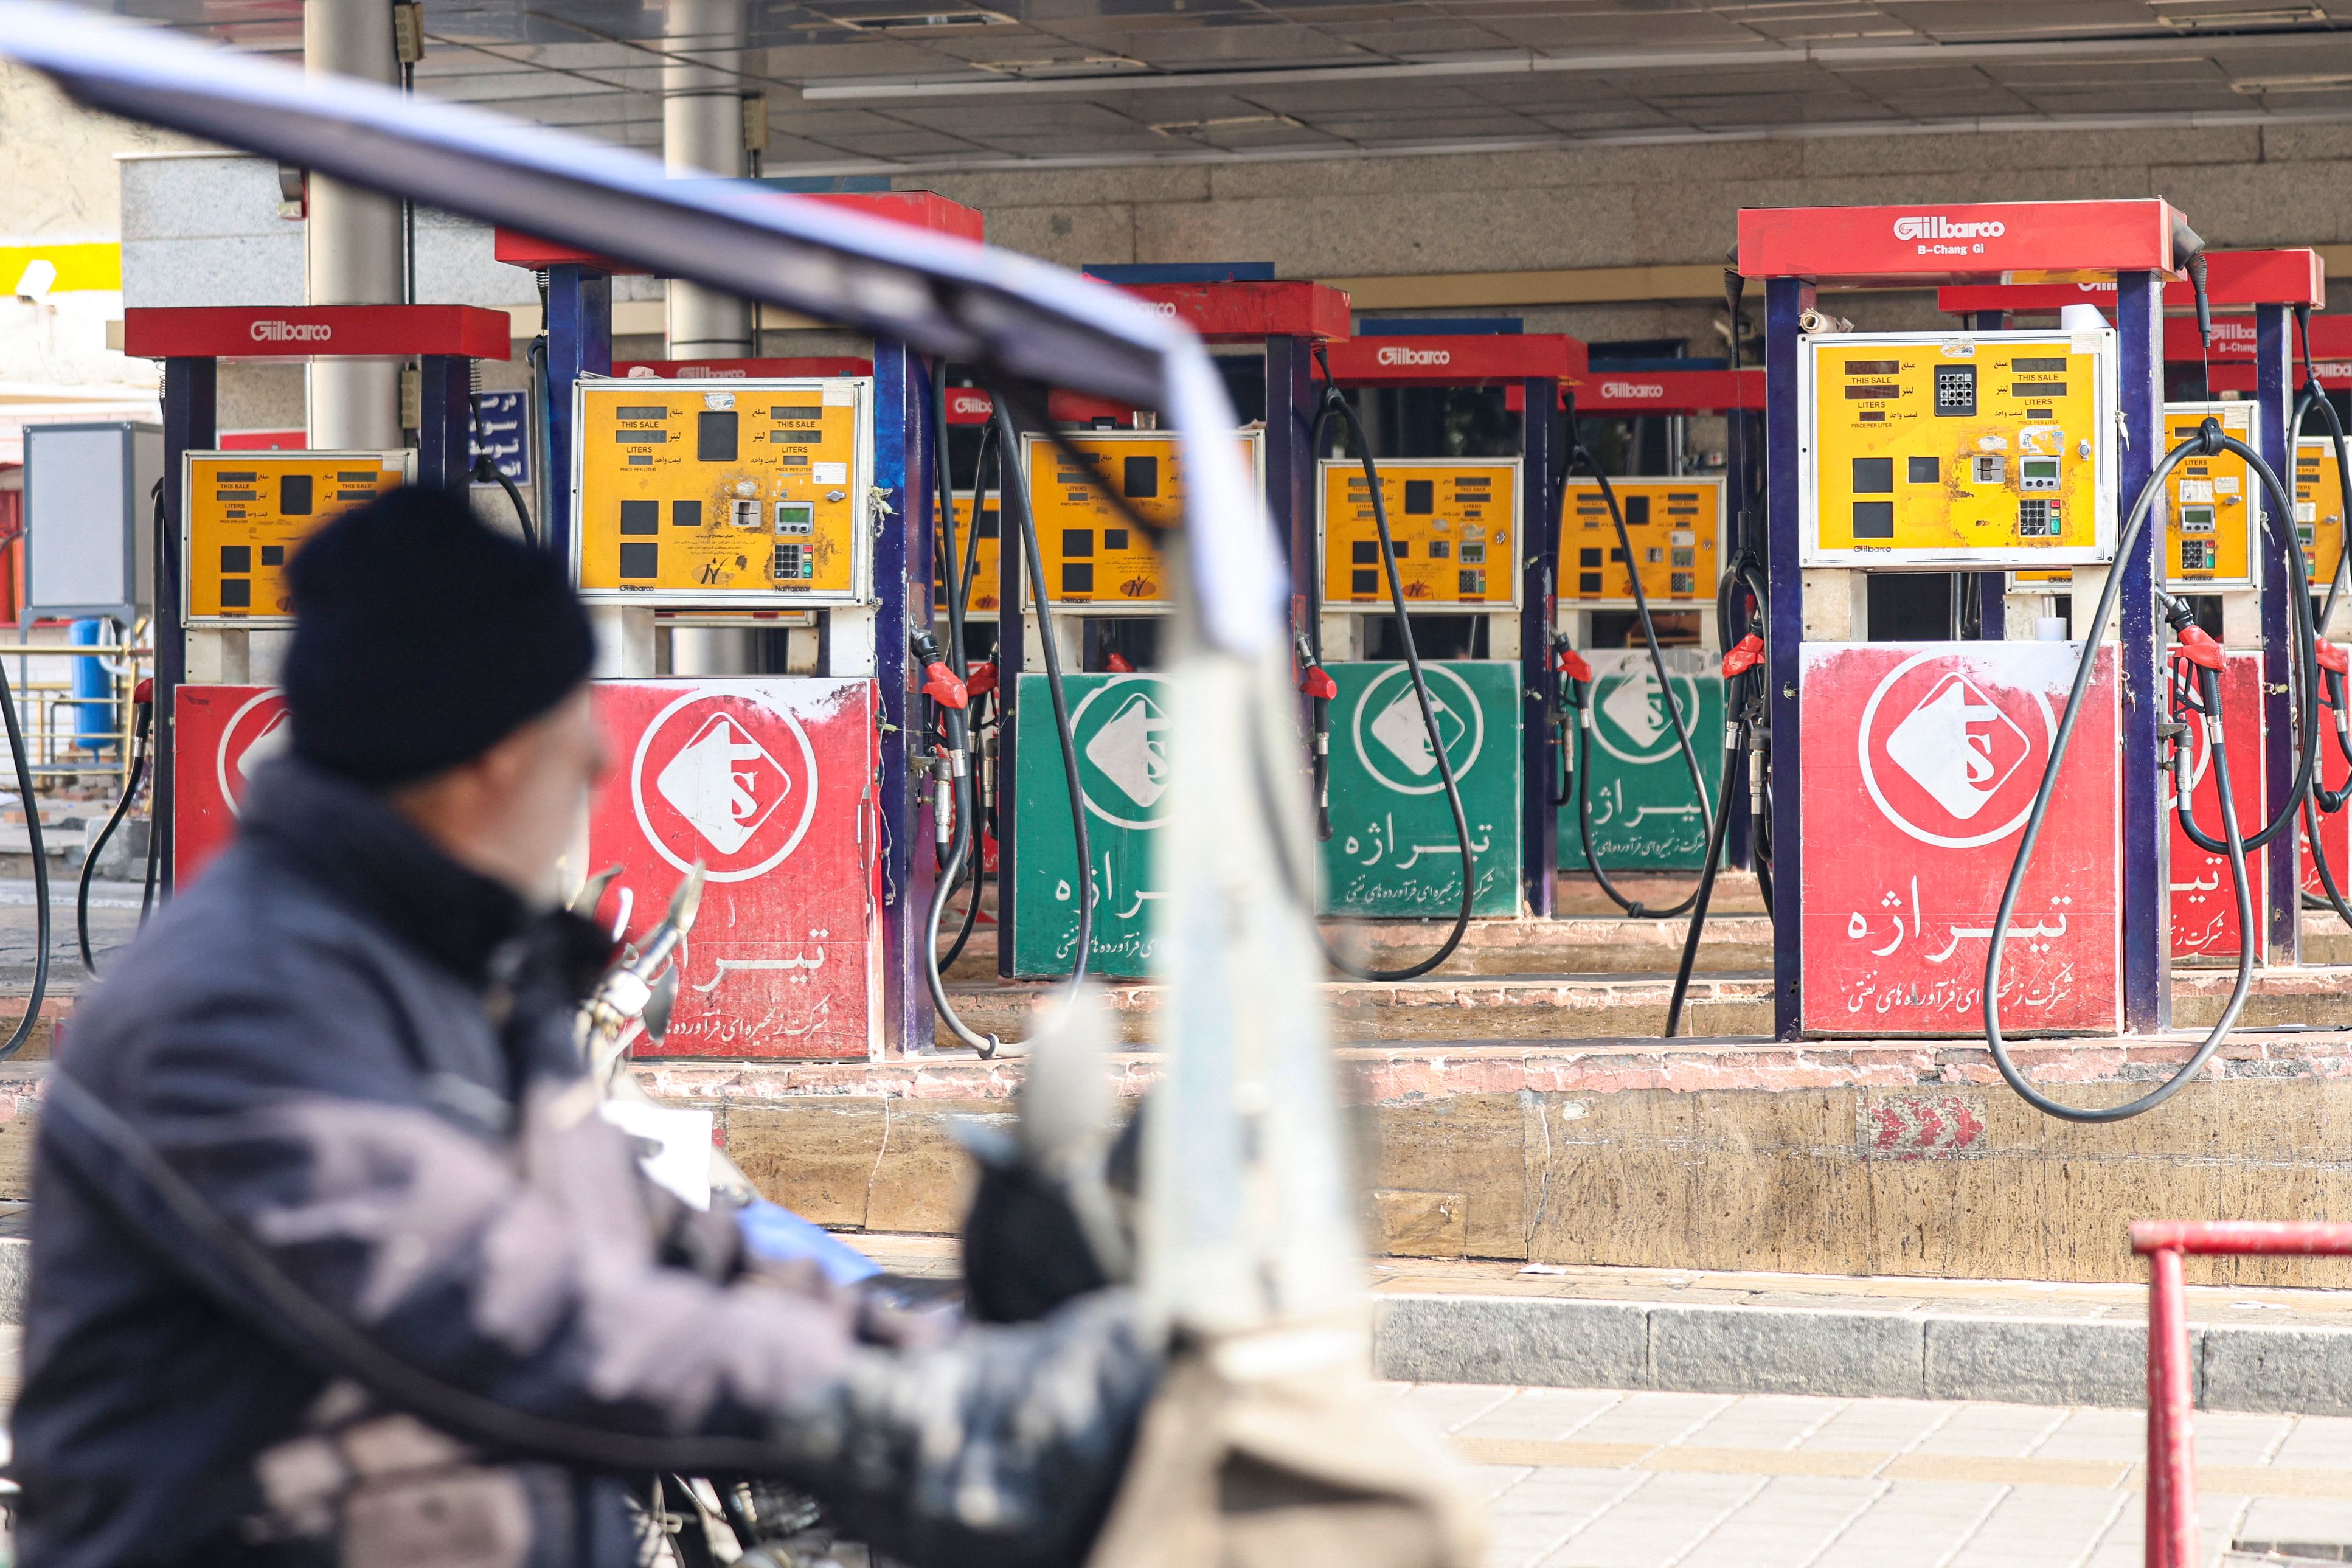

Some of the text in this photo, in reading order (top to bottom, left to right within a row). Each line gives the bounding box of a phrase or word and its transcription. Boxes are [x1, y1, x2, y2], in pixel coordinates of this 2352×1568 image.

[1894, 217, 2005, 240] Gilbarco
[1973, 243, 1984, 254] Gi
[251, 321, 331, 341] Gilbarco
[1378, 347, 1450, 365] Gilbarco
[1901, 361, 1915, 370] مبلغ
[1602, 382, 1663, 398] Gilbarco
[1901, 386, 1913, 397] لیتر
[1996, 385, 2008, 395] لیتر
[670, 409, 683, 417] مبلغ
[752, 409, 766, 418] مبلغ
[668, 432, 681, 442] لیتر
[752, 432, 765, 442] لیتر
[258, 491, 267, 500] لیتر
[324, 491, 333, 500] لیتر
[1346, 874, 1366, 903] نفتی
[2185, 910, 2226, 949] شرکت
[1848, 970, 1877, 1013] نفتی
[2025, 963, 2073, 1011] شرکت
[785, 994, 831, 1041] شرکت
